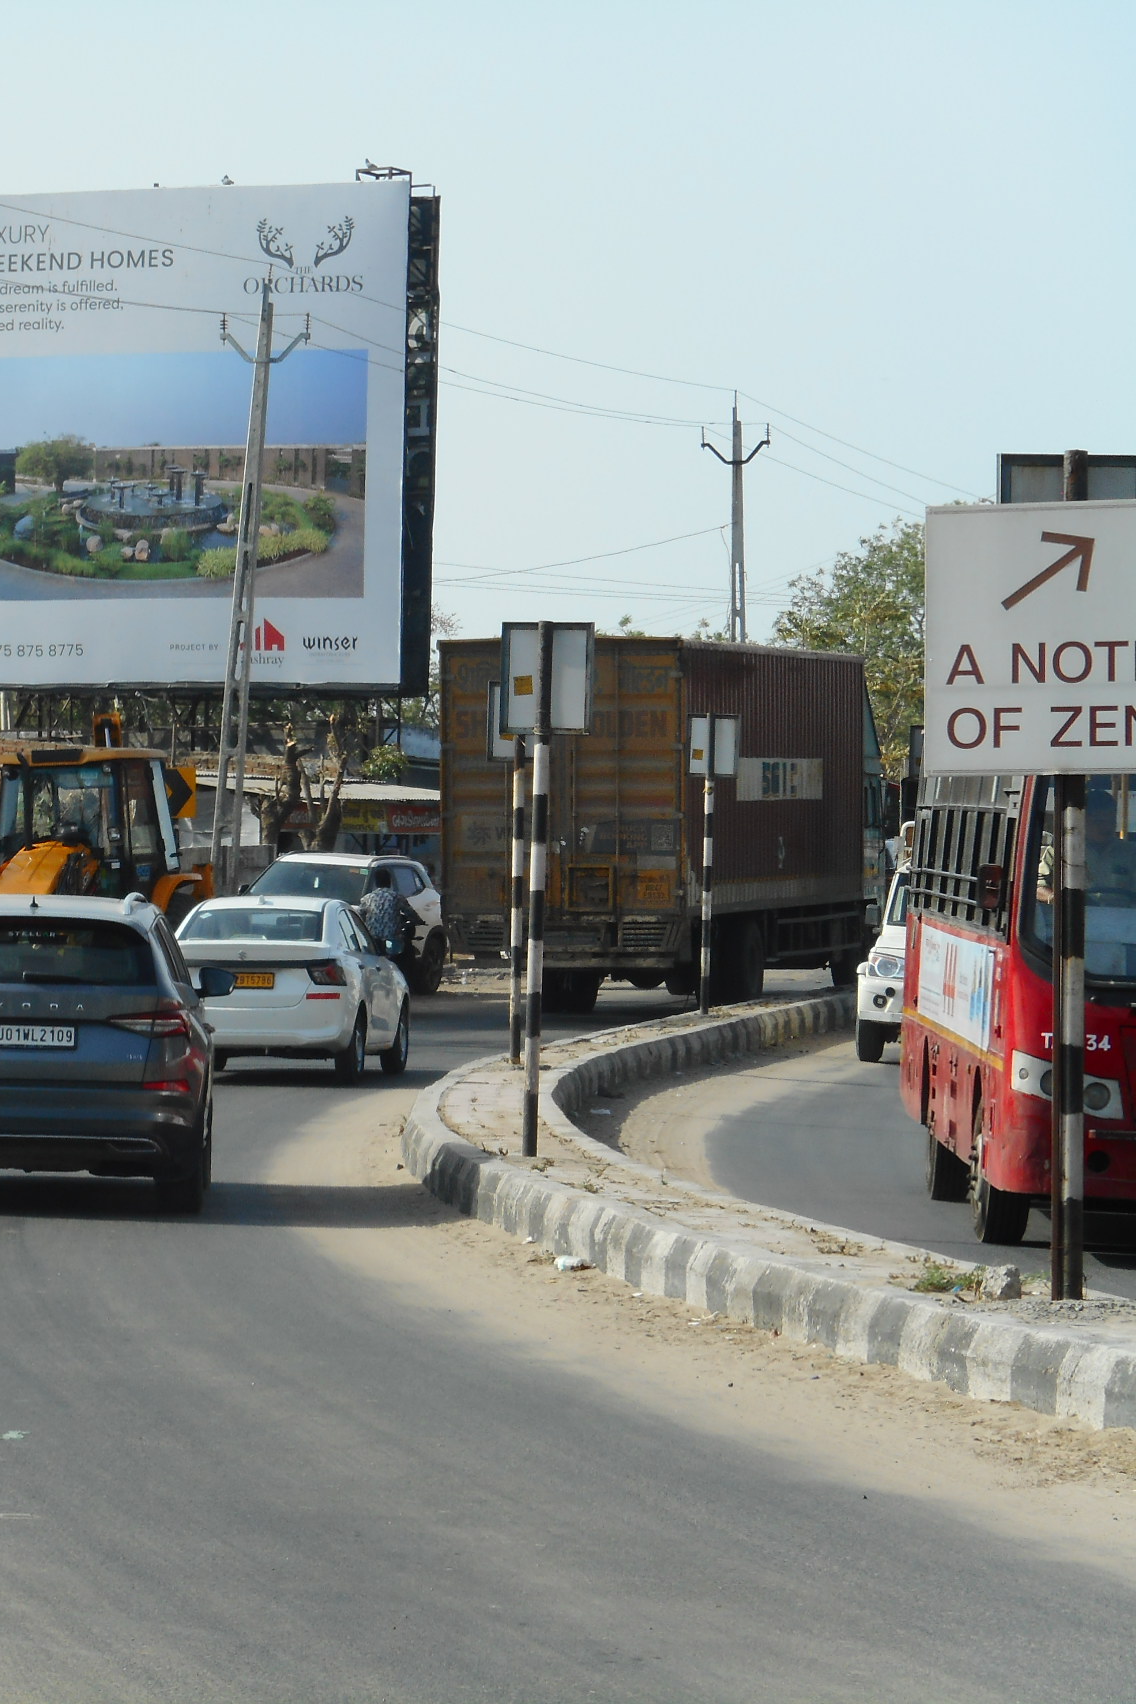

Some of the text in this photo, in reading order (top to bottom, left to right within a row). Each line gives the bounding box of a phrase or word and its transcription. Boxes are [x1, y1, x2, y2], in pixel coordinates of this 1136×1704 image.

[90, 248, 174, 270] HOMES
[0, 282, 44, 295] dream
[48, 281, 58, 294] is
[62, 279, 118, 294] fulfilled.
[0, 299, 53, 315] serenity
[57, 299, 66, 311] is
[18, 317, 65, 333] reality.
[17, 644, 44, 657] 875
[48, 643, 84, 657] 8775
[169, 643, 219, 651] PROJECT BY
[945, 640, 1136, 685] A NOT
[591, 709, 668, 739] OLDEN
[946, 706, 1023, 750] OF
